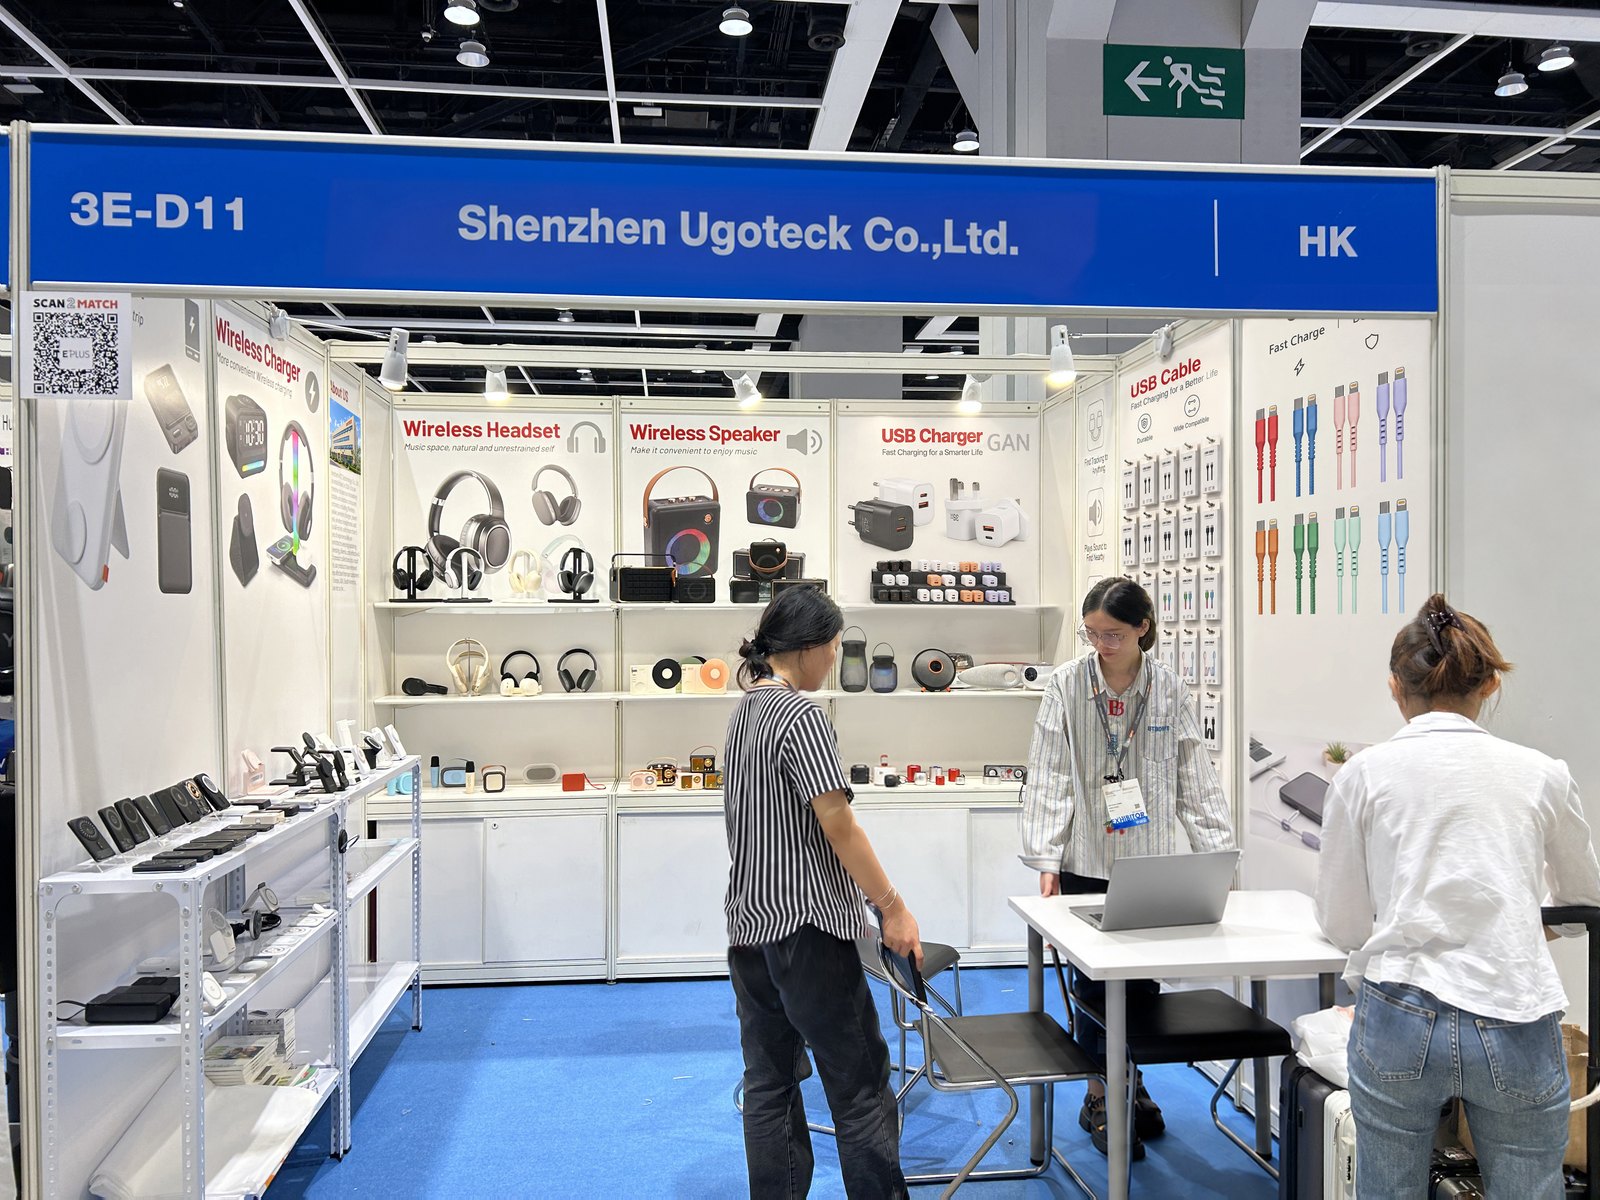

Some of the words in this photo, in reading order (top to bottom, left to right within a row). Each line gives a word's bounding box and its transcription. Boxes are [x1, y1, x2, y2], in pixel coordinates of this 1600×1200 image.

[70, 192, 244, 231] 3E-D11
[458, 204, 666, 245] Shenzhen
[680, 211, 852, 256] Ugoteck
[863, 216, 1019, 260] Co.,Ltd.
[1300, 225, 1358, 257] HK
[215, 315, 263, 363] Wireless
[264, 344, 300, 383] Charger
[1269, 339, 1288, 355] Fast
[1290, 326, 1325, 348] Charge
[229, 359, 256, 380] convenient
[256, 370, 275, 390] Wireless
[275, 381, 293, 399] charging
[1130, 375, 1157, 398] USB
[1160, 358, 1201, 386] Cable
[1130, 398, 1143, 411] Fast
[1143, 389, 1169, 408] Charging
[1170, 384, 1178, 396] for
[1179, 383, 1184, 391] a
[1185, 374, 1204, 389] Better
[1206, 368, 1219, 381] Life
[403, 420, 483, 438] Wireless
[487, 422, 561, 439] Headset
[629, 424, 706, 442] Wireless
[709, 425, 781, 445] Speaker
[1173, 422, 1184, 433] Wide
[1185, 415, 1210, 431] Compatible
[404, 443, 425, 452] Music
[426, 445, 450, 453] space,
[451, 444, 478, 453] natural
[479, 444, 493, 452] and
[493, 444, 540, 453] unrestrained
[541, 445, 556, 453] self
[630, 446, 650, 455] Make
[651, 446, 659, 455] it
[659, 447, 702, 456] convenient
[703, 448, 712, 456] to
[713, 448, 734, 457] enjoy
[734, 448, 758, 456] music
[881, 428, 916, 444] USB
[919, 428, 983, 447] Charger
[987, 433, 1030, 452] GAN
[1136, 434, 1154, 445] Durable
[881, 448, 896, 456] Fast
[897, 448, 928, 458] Charging
[928, 448, 938, 457] for
[944, 449, 970, 457] Smarter
[971, 449, 984, 457] Life
[1111, 811, 1145, 824] EXHIBITOR
